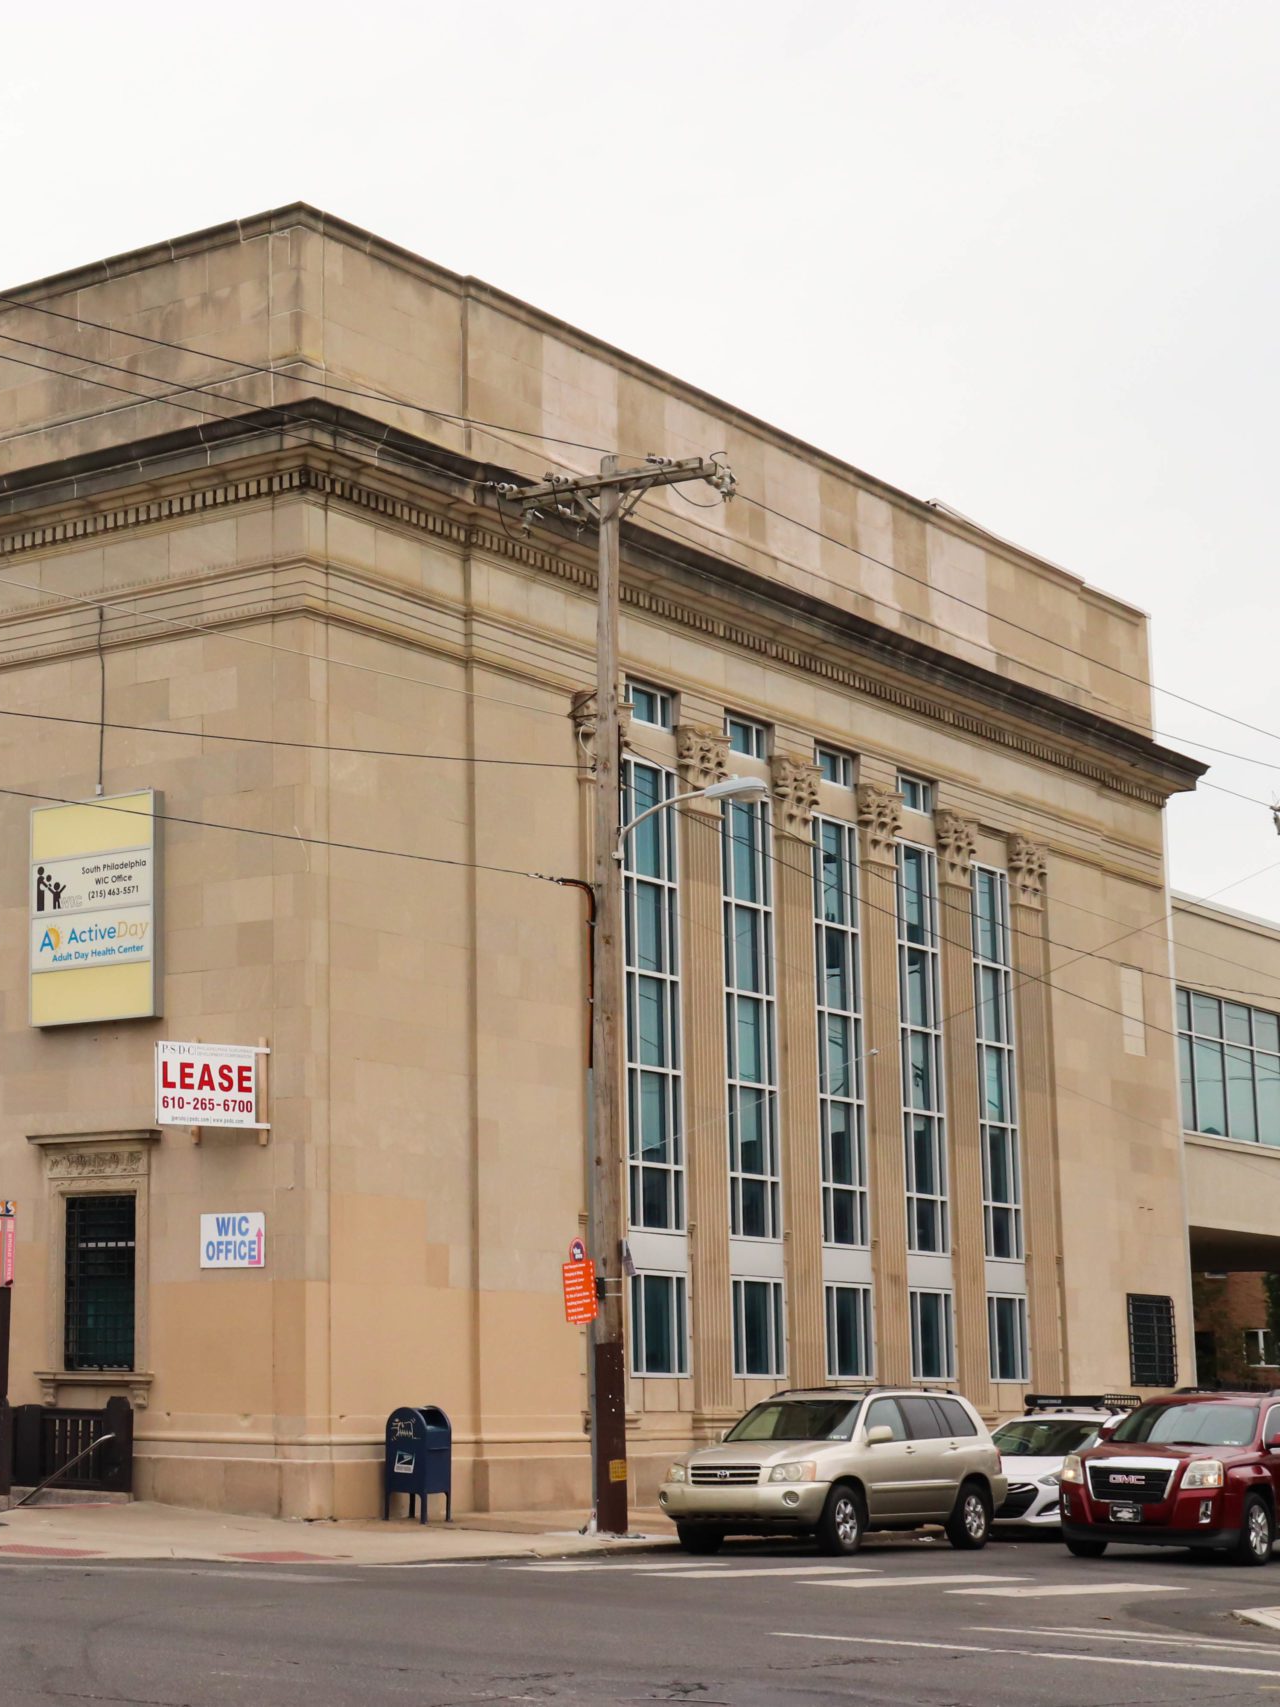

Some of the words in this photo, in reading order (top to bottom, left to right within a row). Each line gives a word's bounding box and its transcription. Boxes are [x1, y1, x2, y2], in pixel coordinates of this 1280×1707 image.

[81, 865, 101, 875] South
[103, 859, 147, 871] Philadelphia
[95, 877, 109, 885] WIC
[111, 874, 133, 884] Office
[88, 889, 106, 901] (215)
[107, 885, 139, 897] 463-5571
[52, 952, 72, 962] Adult
[74, 951, 89, 961] Day
[91, 946, 116, 957] Health
[117, 944, 145, 954] Center
[162, 1061, 253, 1093] LEASE
[162, 1095, 253, 1113] 610-265-6700
[215, 1216, 250, 1237] WIC
[206, 1240, 257, 1261] OFFICE
[1109, 1474, 1146, 1485] GMC
